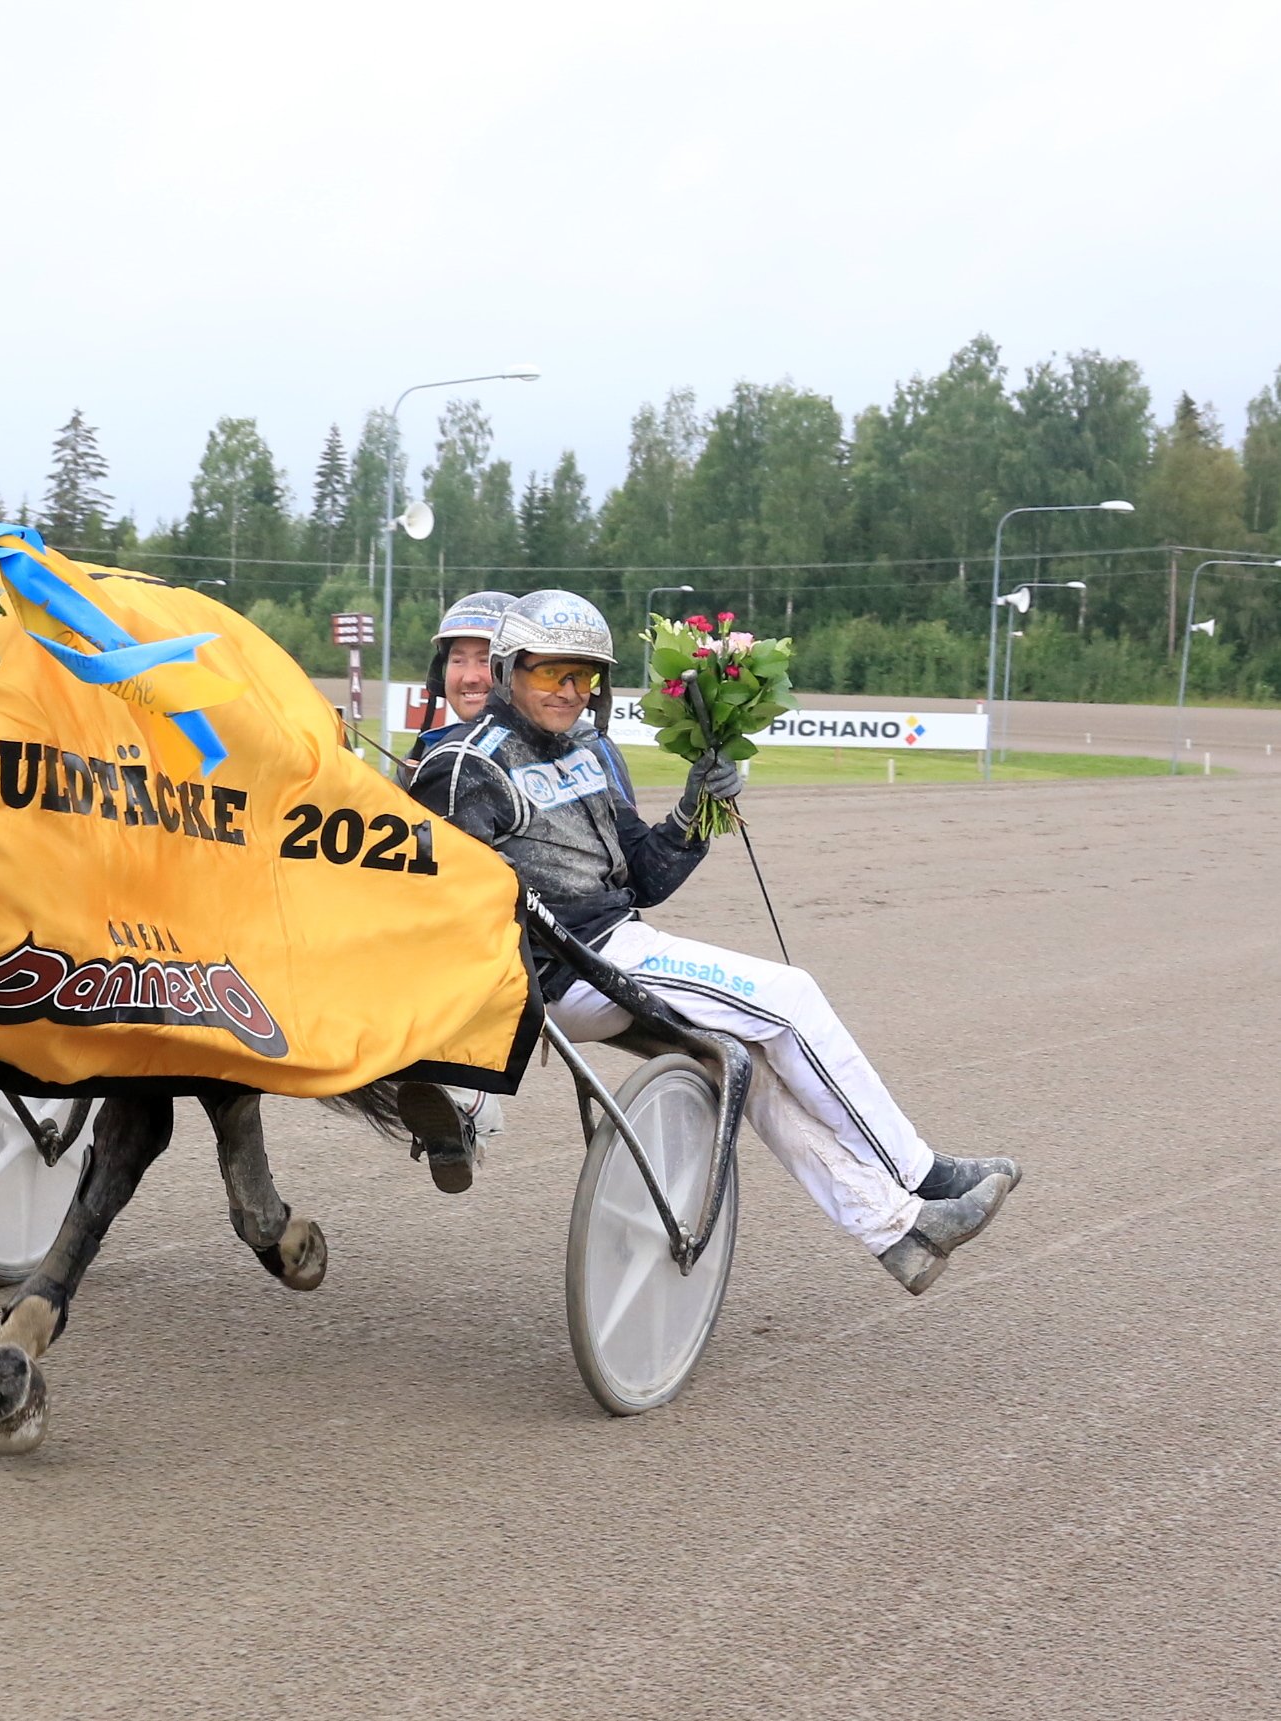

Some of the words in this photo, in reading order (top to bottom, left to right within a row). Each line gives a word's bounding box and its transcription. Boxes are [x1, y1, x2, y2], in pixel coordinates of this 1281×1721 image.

[769, 719, 900, 738] PICHANO
[280, 803, 439, 876] 2021
[638, 954, 756, 997] lotusab.se
